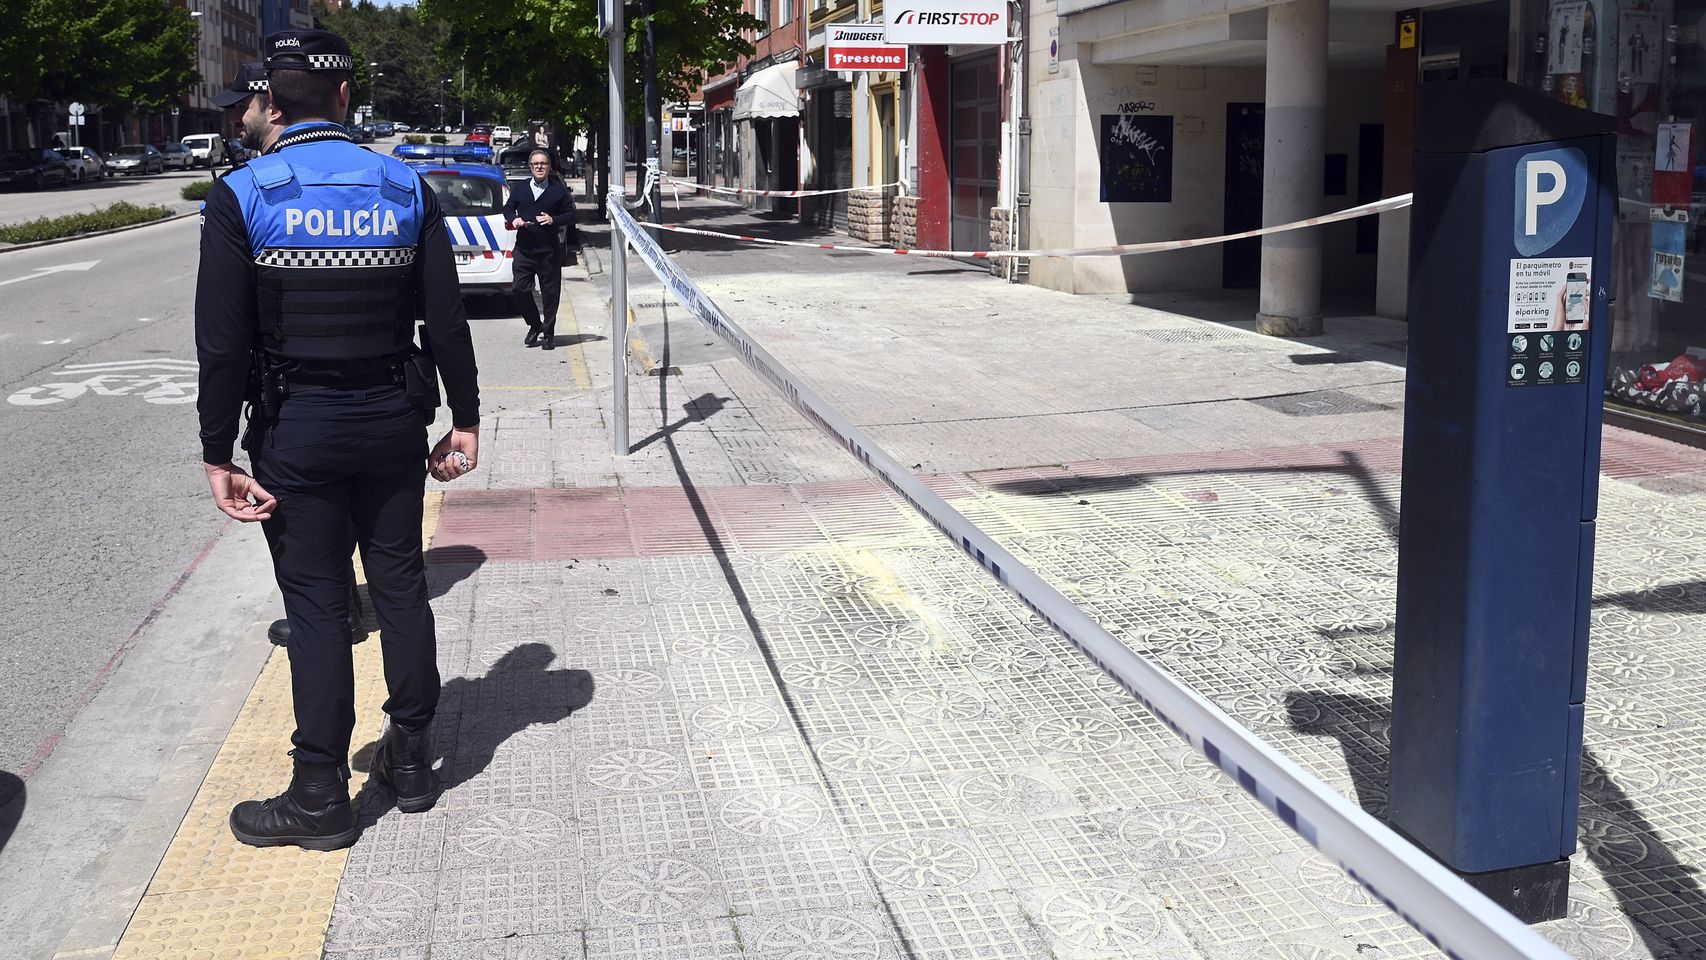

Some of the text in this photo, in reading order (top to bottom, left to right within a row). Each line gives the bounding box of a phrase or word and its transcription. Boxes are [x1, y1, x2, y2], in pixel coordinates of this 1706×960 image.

[918, 12, 1000, 25] FIRSTSTOP
[275, 37, 300, 48] POLICÍA
[833, 53, 901, 65] Firestone
[1525, 160, 1567, 236] P
[285, 202, 399, 237] POLICÍA
[1515, 307, 1550, 317] elparking
